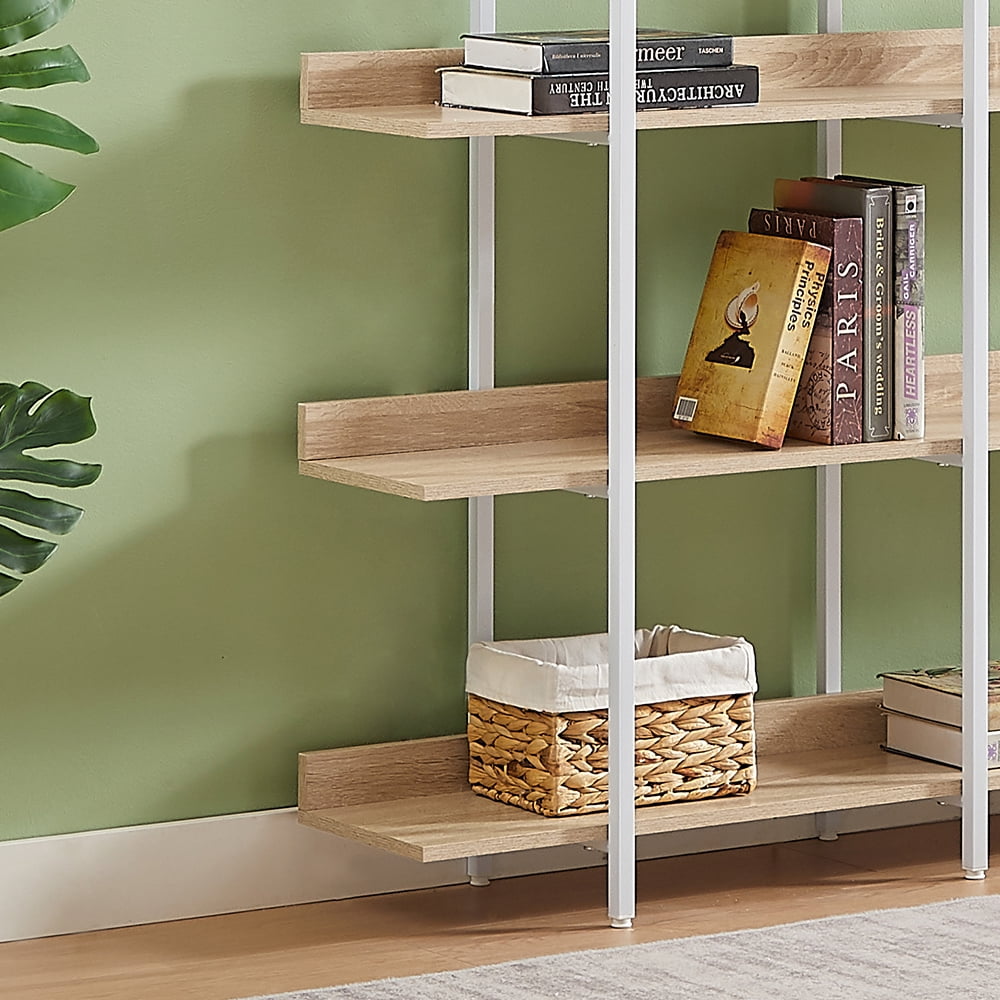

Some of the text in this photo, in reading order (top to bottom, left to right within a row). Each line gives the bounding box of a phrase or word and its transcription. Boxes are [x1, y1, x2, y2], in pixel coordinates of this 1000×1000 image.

[636, 46, 685, 62] meer
[549, 81, 593, 95] CENTURY
[569, 92, 603, 107] THE
[635, 84, 745, 104] ARCHITECYUR
[763, 213, 817, 239] PARIS
[875, 217, 885, 260] Bride
[875, 263, 885, 278] &
[787, 260, 815, 332] Principles
[801, 271, 826, 329] Physics
[836, 261, 859, 402] PARIS
[905, 310, 917, 397] HEARTLESS
[874, 353, 885, 416] wedding
